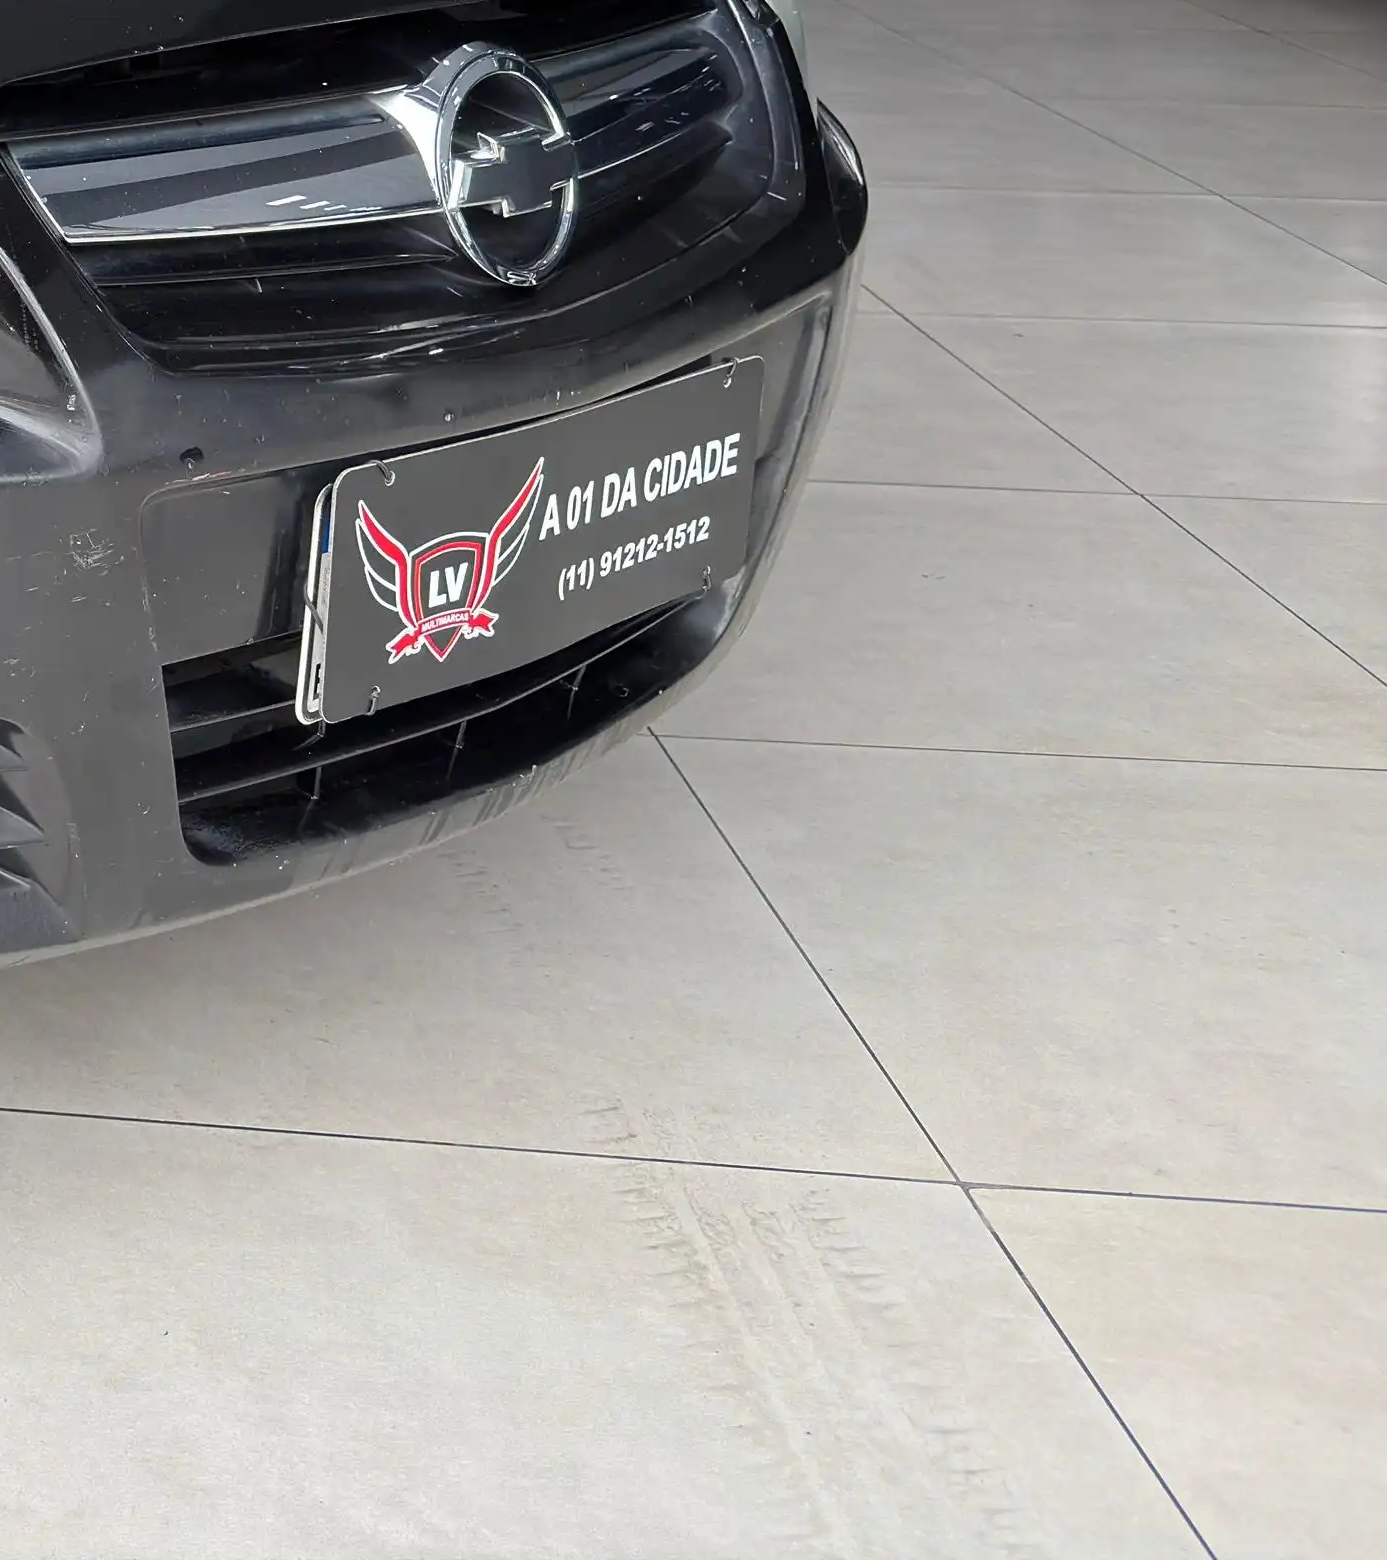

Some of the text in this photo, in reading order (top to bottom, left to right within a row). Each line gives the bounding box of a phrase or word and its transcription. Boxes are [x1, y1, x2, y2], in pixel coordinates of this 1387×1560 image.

[539, 432, 741, 541] A 01 DA CIDADE
[428, 561, 469, 608] LV
[558, 515, 710, 601] (11) 91212-1512
[421, 612, 469, 633] MULTIMARCAS
